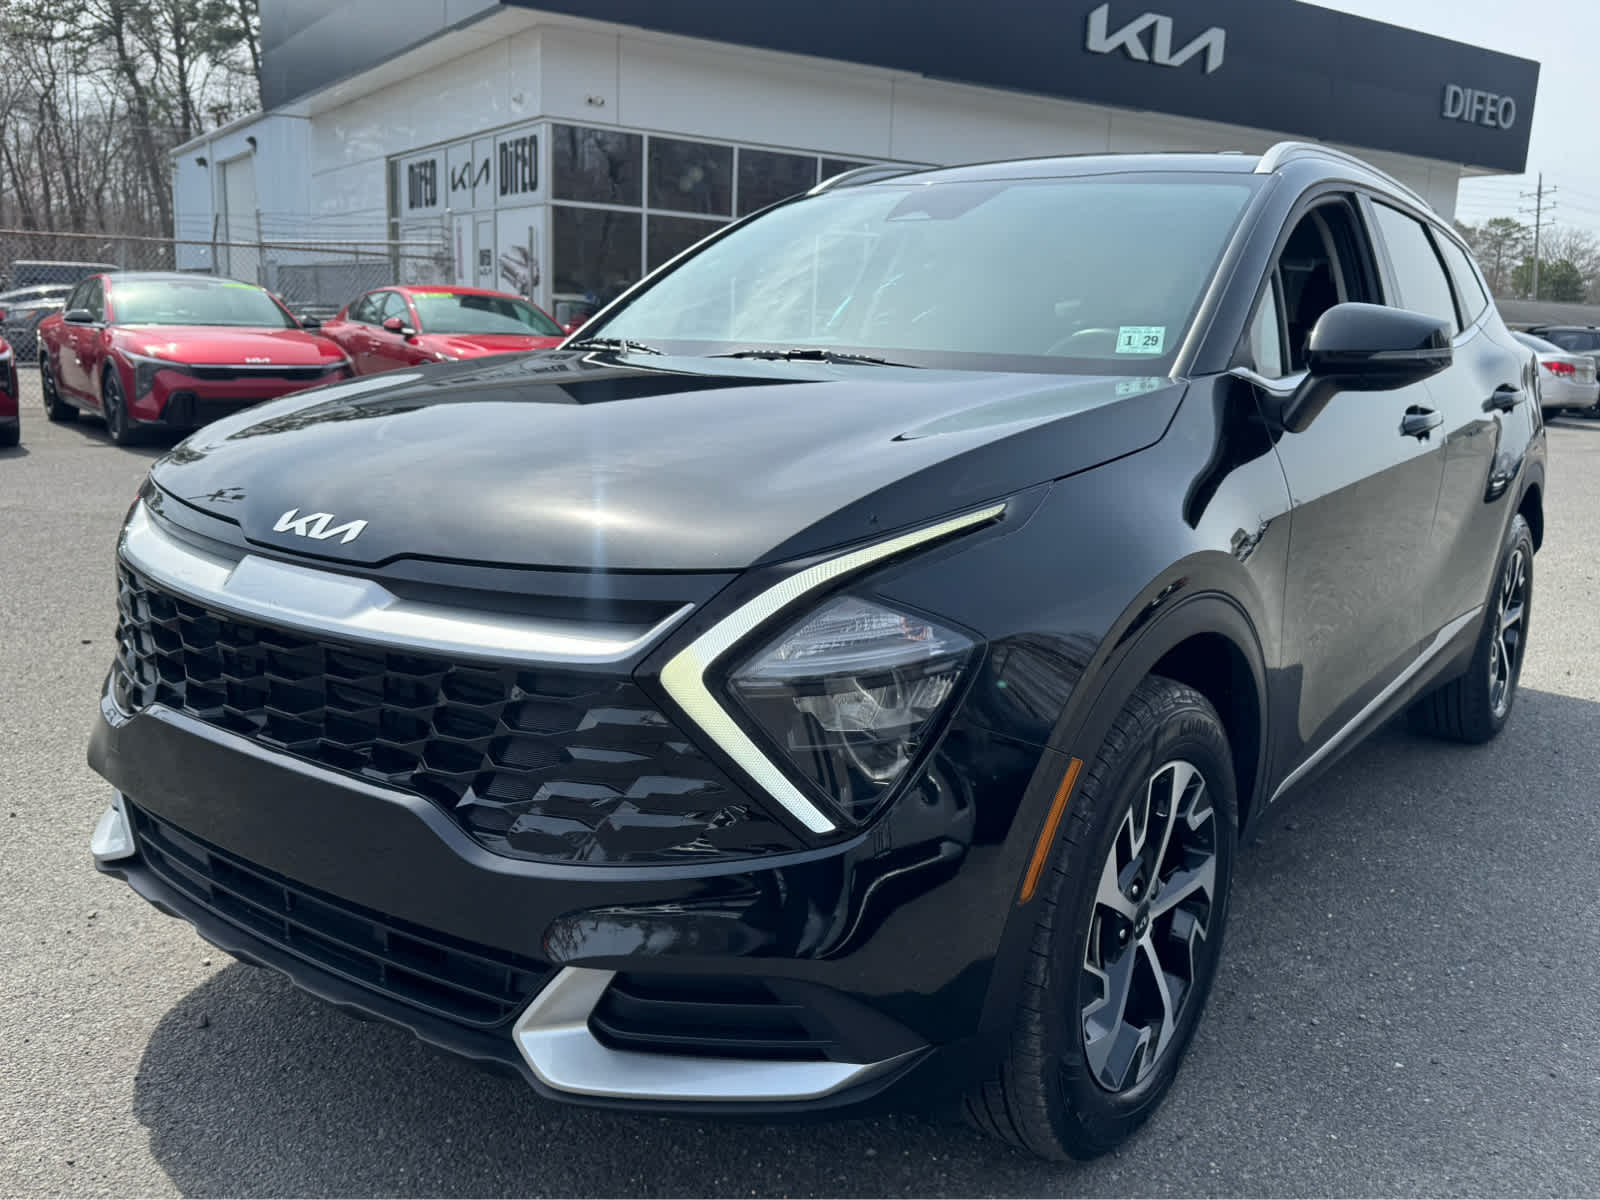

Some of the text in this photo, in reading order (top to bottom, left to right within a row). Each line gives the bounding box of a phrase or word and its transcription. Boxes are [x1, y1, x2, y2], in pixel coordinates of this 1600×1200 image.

[1087, 3, 1226, 74] KIA
[1443, 84, 1516, 129] DIFEO
[451, 158, 490, 192] KIA
[1124, 335, 1159, 346] 1 29
[273, 508, 369, 544] KIA
